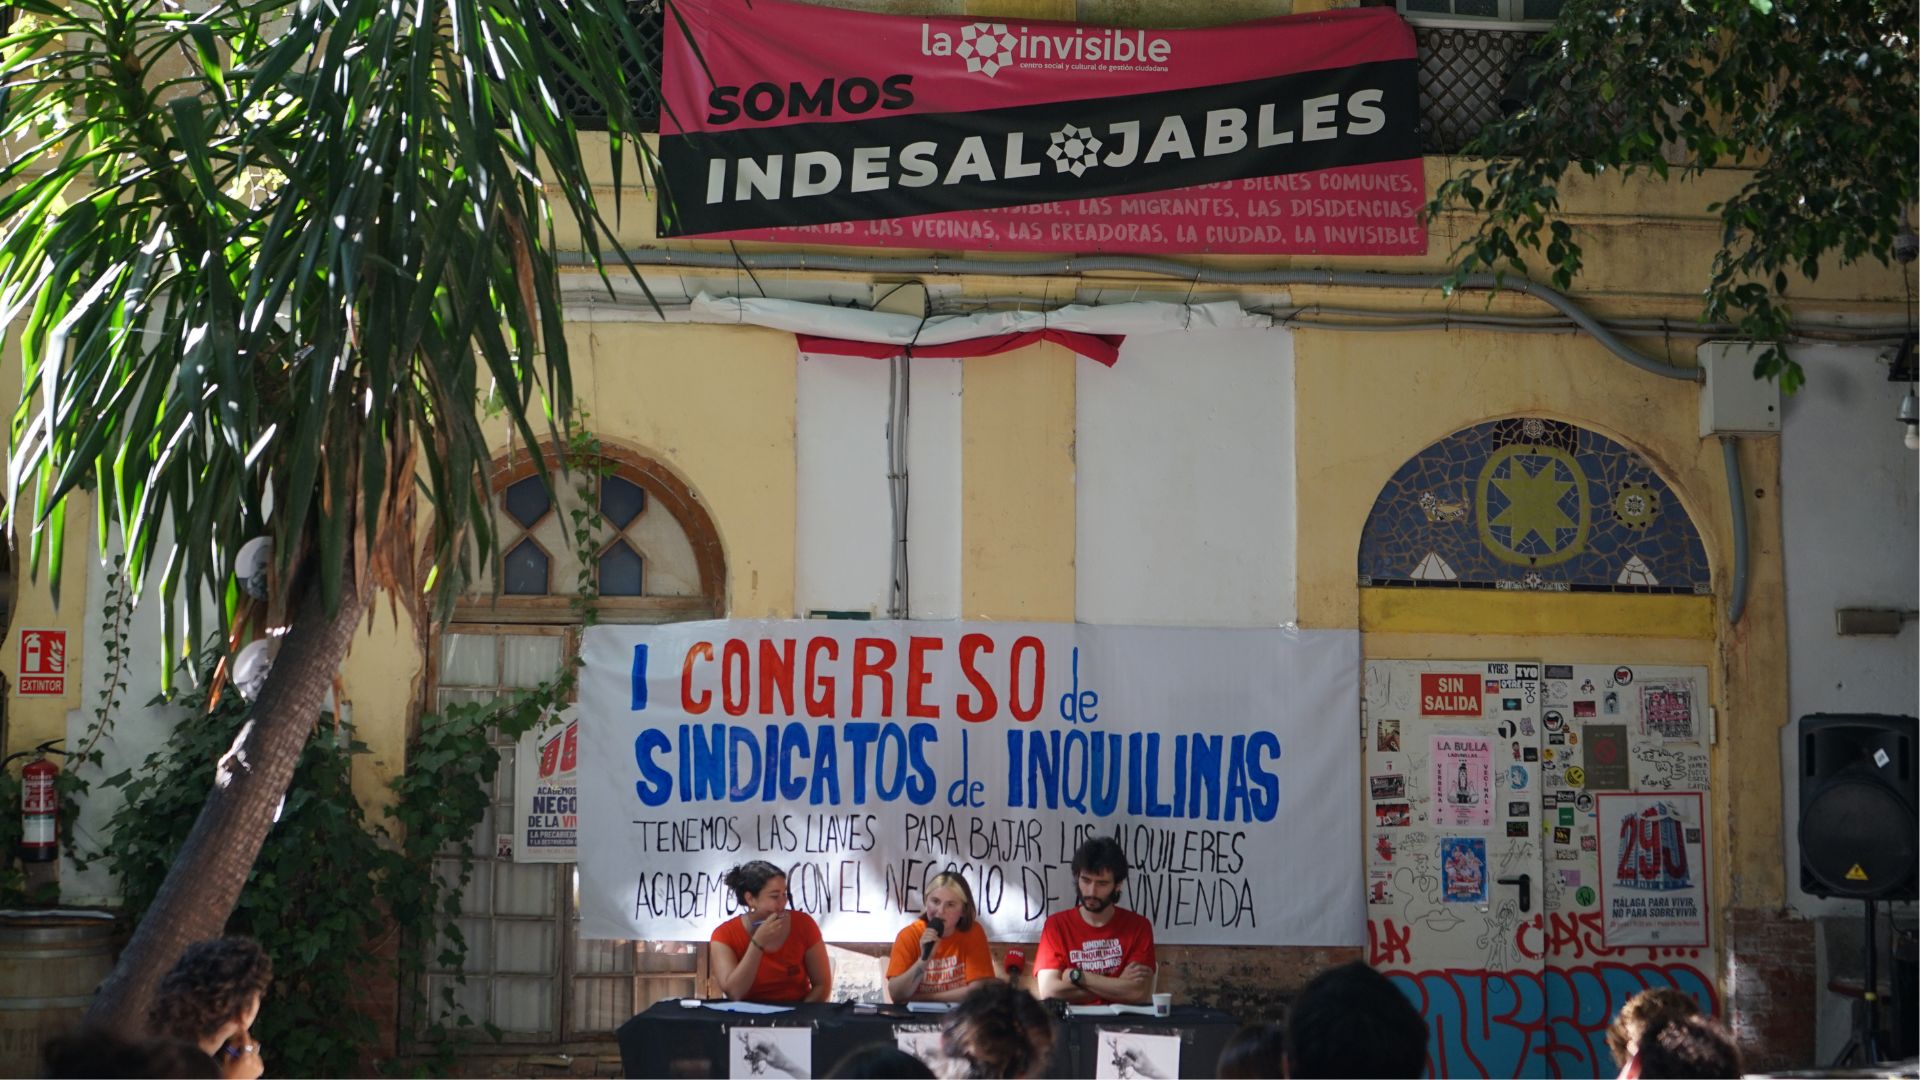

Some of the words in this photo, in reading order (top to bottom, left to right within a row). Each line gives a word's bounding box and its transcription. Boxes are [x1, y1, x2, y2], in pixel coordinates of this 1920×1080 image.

[921, 24, 952, 56] la
[1020, 27, 1172, 62] invisible
[1044, 62, 1064, 70] social
[1071, 63, 1097, 71] cultural
[1109, 63, 1133, 72] gestión
[1135, 64, 1169, 72] ciudadana
[707, 74, 914, 125] SOMOS
[1242, 174, 1312, 192] BIENES
[1319, 173, 1418, 193] COMUNES,
[1078, 199, 1113, 216] LAS
[1121, 198, 1240, 219] MIGRANTES,
[1248, 199, 1282, 218] LAS
[911, 219, 1000, 241] VECINAS,
[1008, 220, 1043, 241] LAS
[1051, 222, 1168, 244] CREADORAS,
[1176, 224, 1198, 243] LA
[1294, 225, 1316, 243] LA
[1324, 225, 1420, 245] INVISIBLE
[21, 679, 62, 692] EXTINTOR
[631, 643, 648, 711] I
[681, 633, 1045, 723] CONGRESO
[1060, 646, 1098, 724] de
[1438, 677, 1464, 693] SIN
[1424, 695, 1478, 711] SALIDA
[1437, 742, 1451, 751] LA
[1455, 742, 1488, 752] BULLA
[635, 722, 938, 807] SINDICATOS
[948, 729, 985, 807] de
[1007, 728, 1281, 823] INQUILINAS
[528, 815, 542, 828] DE
[545, 815, 559, 828] LA
[632, 816, 742, 852] TENEMOS
[757, 815, 797, 852] LAS
[805, 814, 877, 853] LLAVES
[905, 813, 959, 855] PARA
[969, 817, 1042, 863] BAJAR
[787, 861, 832, 915] CON
[839, 860, 871, 914] EL
[1022, 865, 1060, 922] DE
[1127, 873, 1256, 930] VIVIENDA
[1613, 896, 1646, 908] MÁLAGA
[1648, 897, 1670, 907] PARA
[1672, 897, 1696, 909] VIVIR,
[1612, 908, 1624, 918] NO
[1626, 908, 1648, 918] PARA
[1649, 907, 1697, 918] SOBREVIVIR
[1082, 938, 1119, 950] SINDICATO
[1368, 919, 1411, 965] LA
[1071, 952, 1080, 961] DE
[1082, 946, 1121, 961] INQUILINAS
[1082, 958, 1122, 971] INQUILINOS
